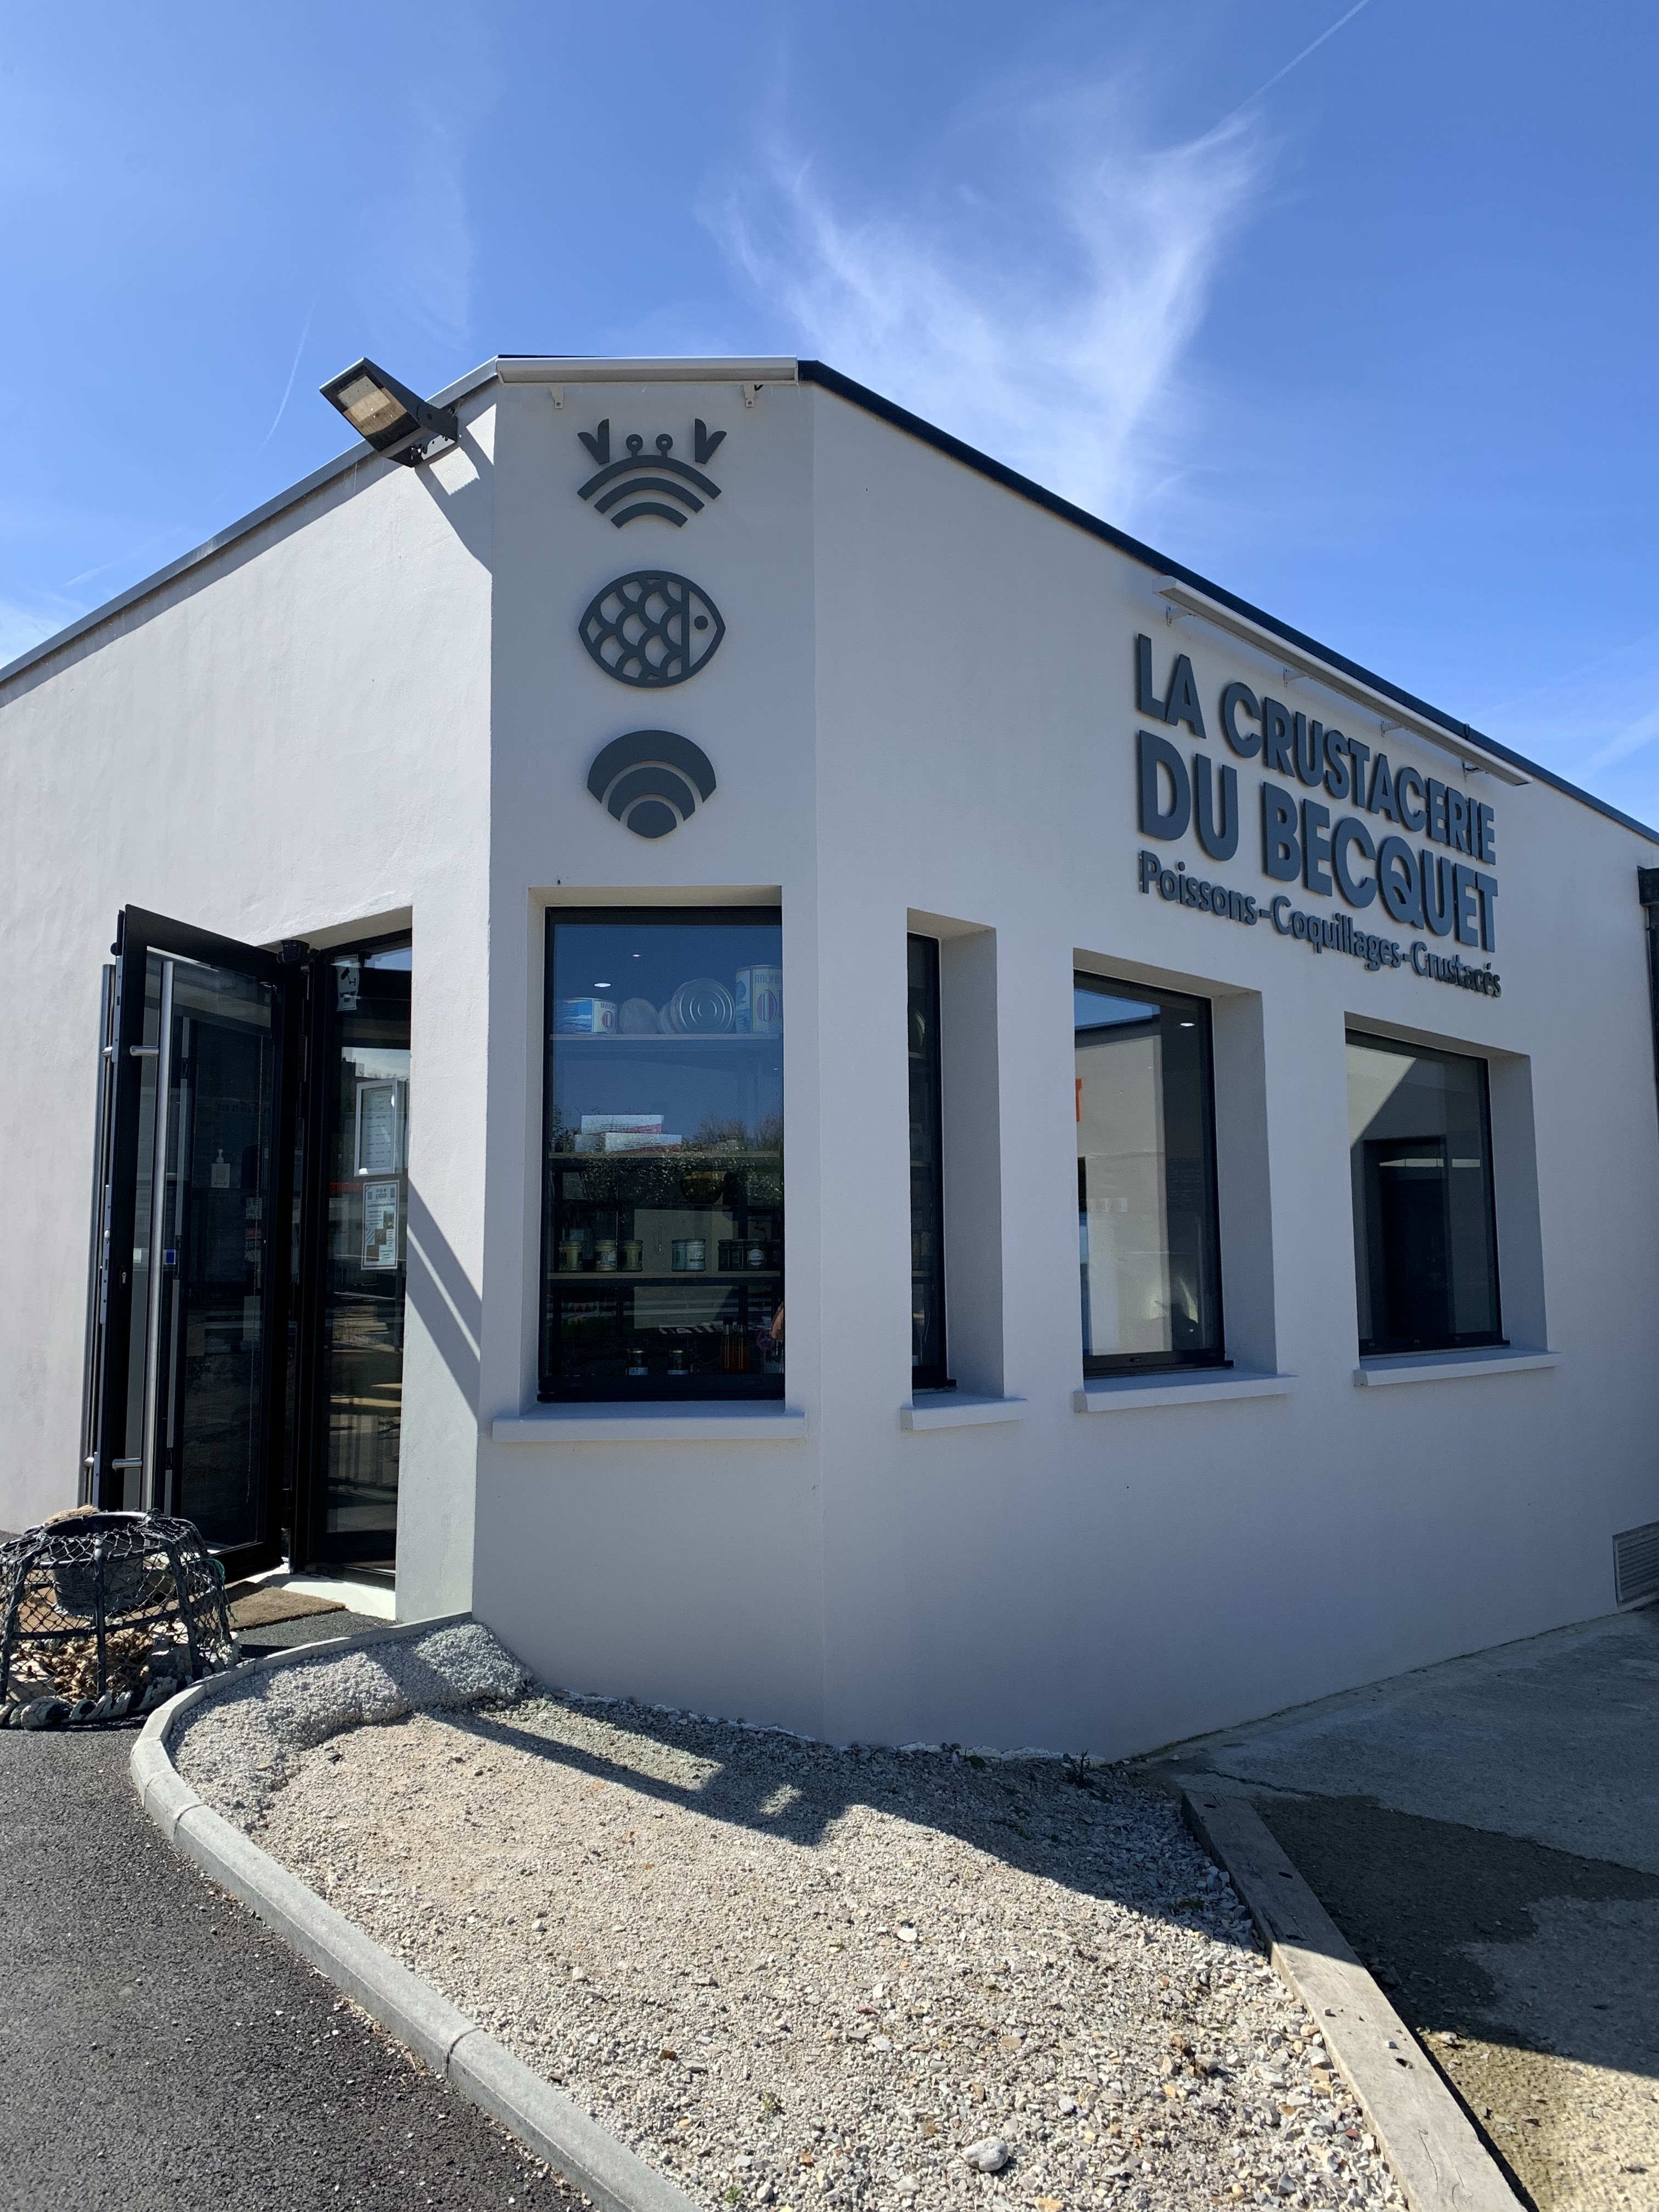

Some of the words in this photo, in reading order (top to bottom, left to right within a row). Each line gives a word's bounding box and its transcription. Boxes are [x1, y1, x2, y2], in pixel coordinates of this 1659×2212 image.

[1138, 633, 1206, 739] LA
[1222, 682, 1496, 866] CRUSTACERIE
[1139, 730, 1239, 861] DU
[1262, 781, 1498, 953] BECQUET
